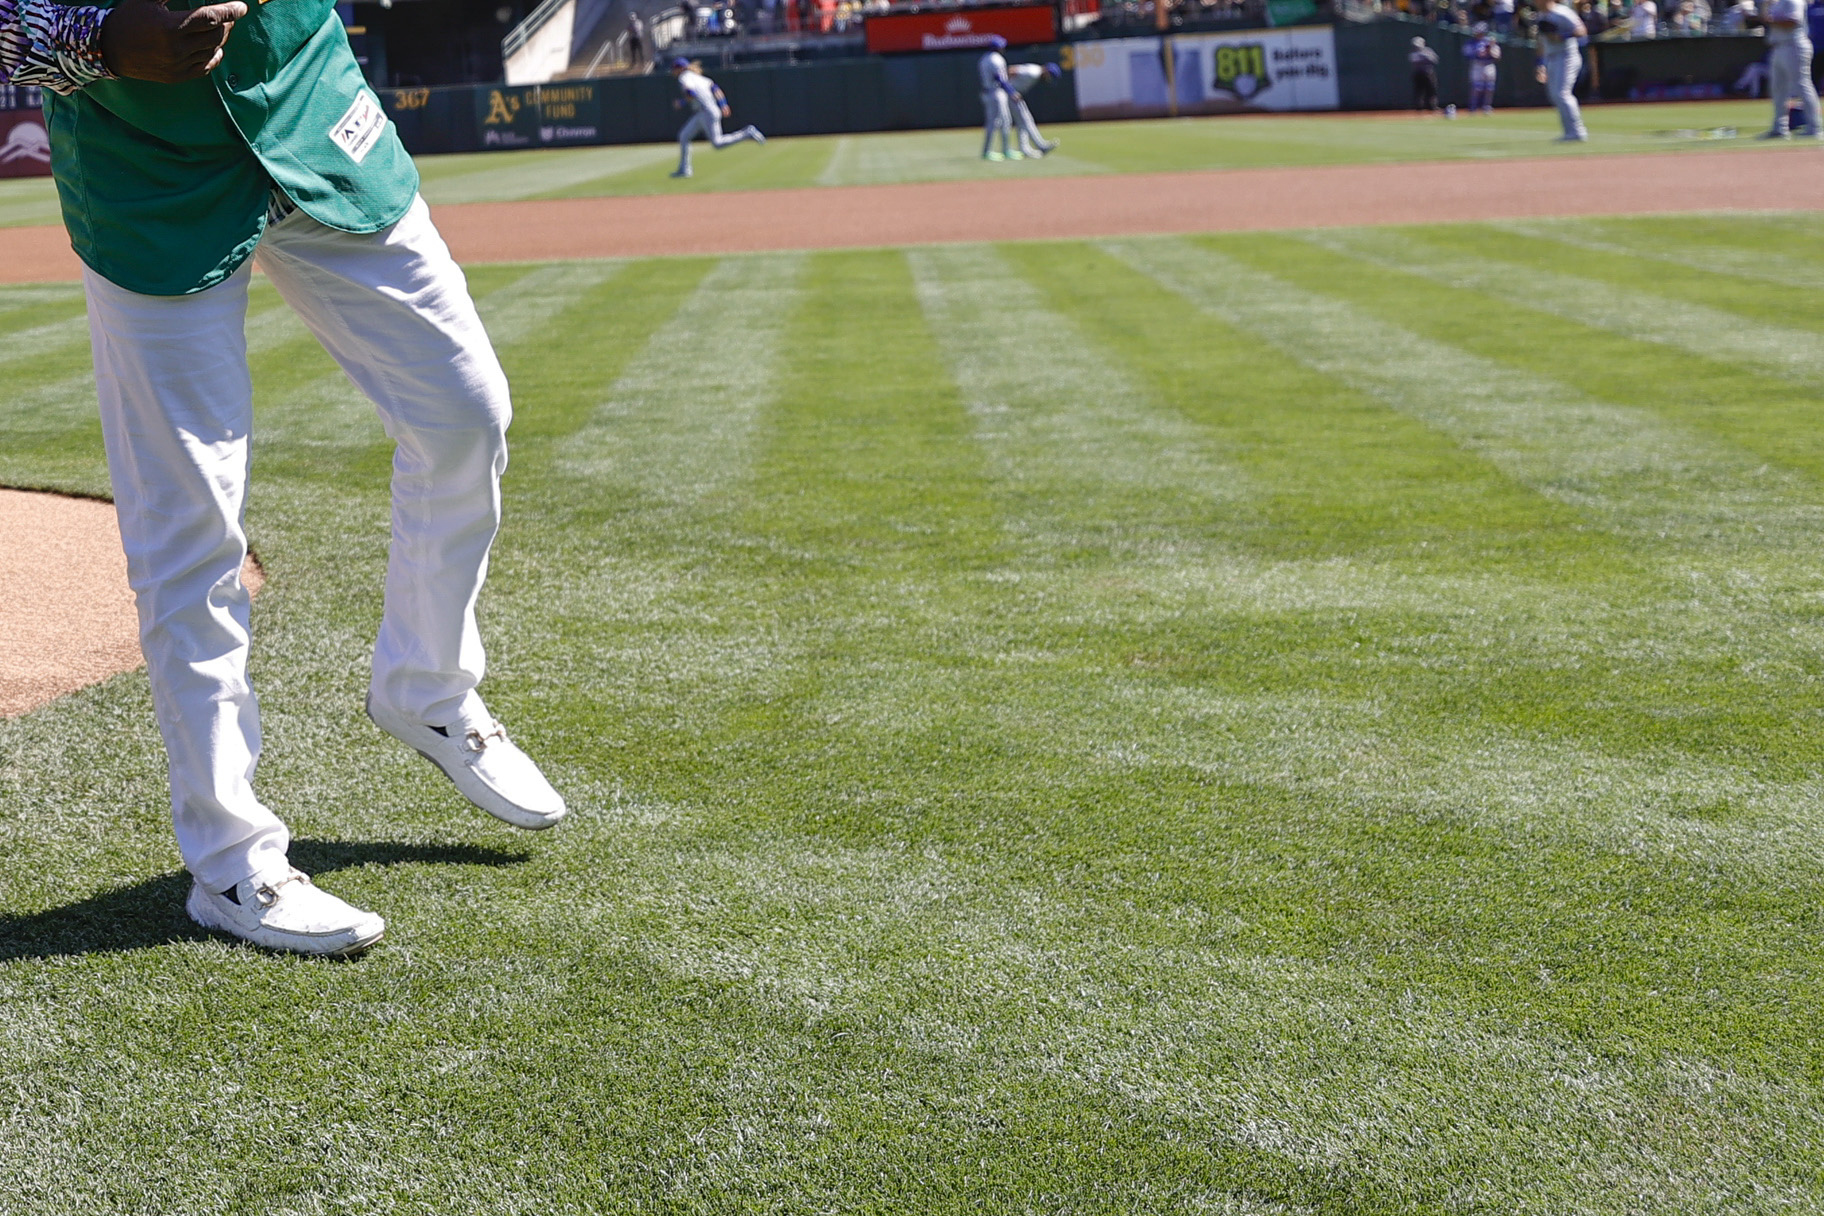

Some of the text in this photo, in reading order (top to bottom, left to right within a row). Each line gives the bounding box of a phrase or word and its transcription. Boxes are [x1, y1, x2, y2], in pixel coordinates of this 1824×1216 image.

[1215, 45, 1265, 81] 811
[395, 90, 430, 109] 367
[525, 86, 593, 105] COMMUNITY
[546, 104, 575, 119] FUND
